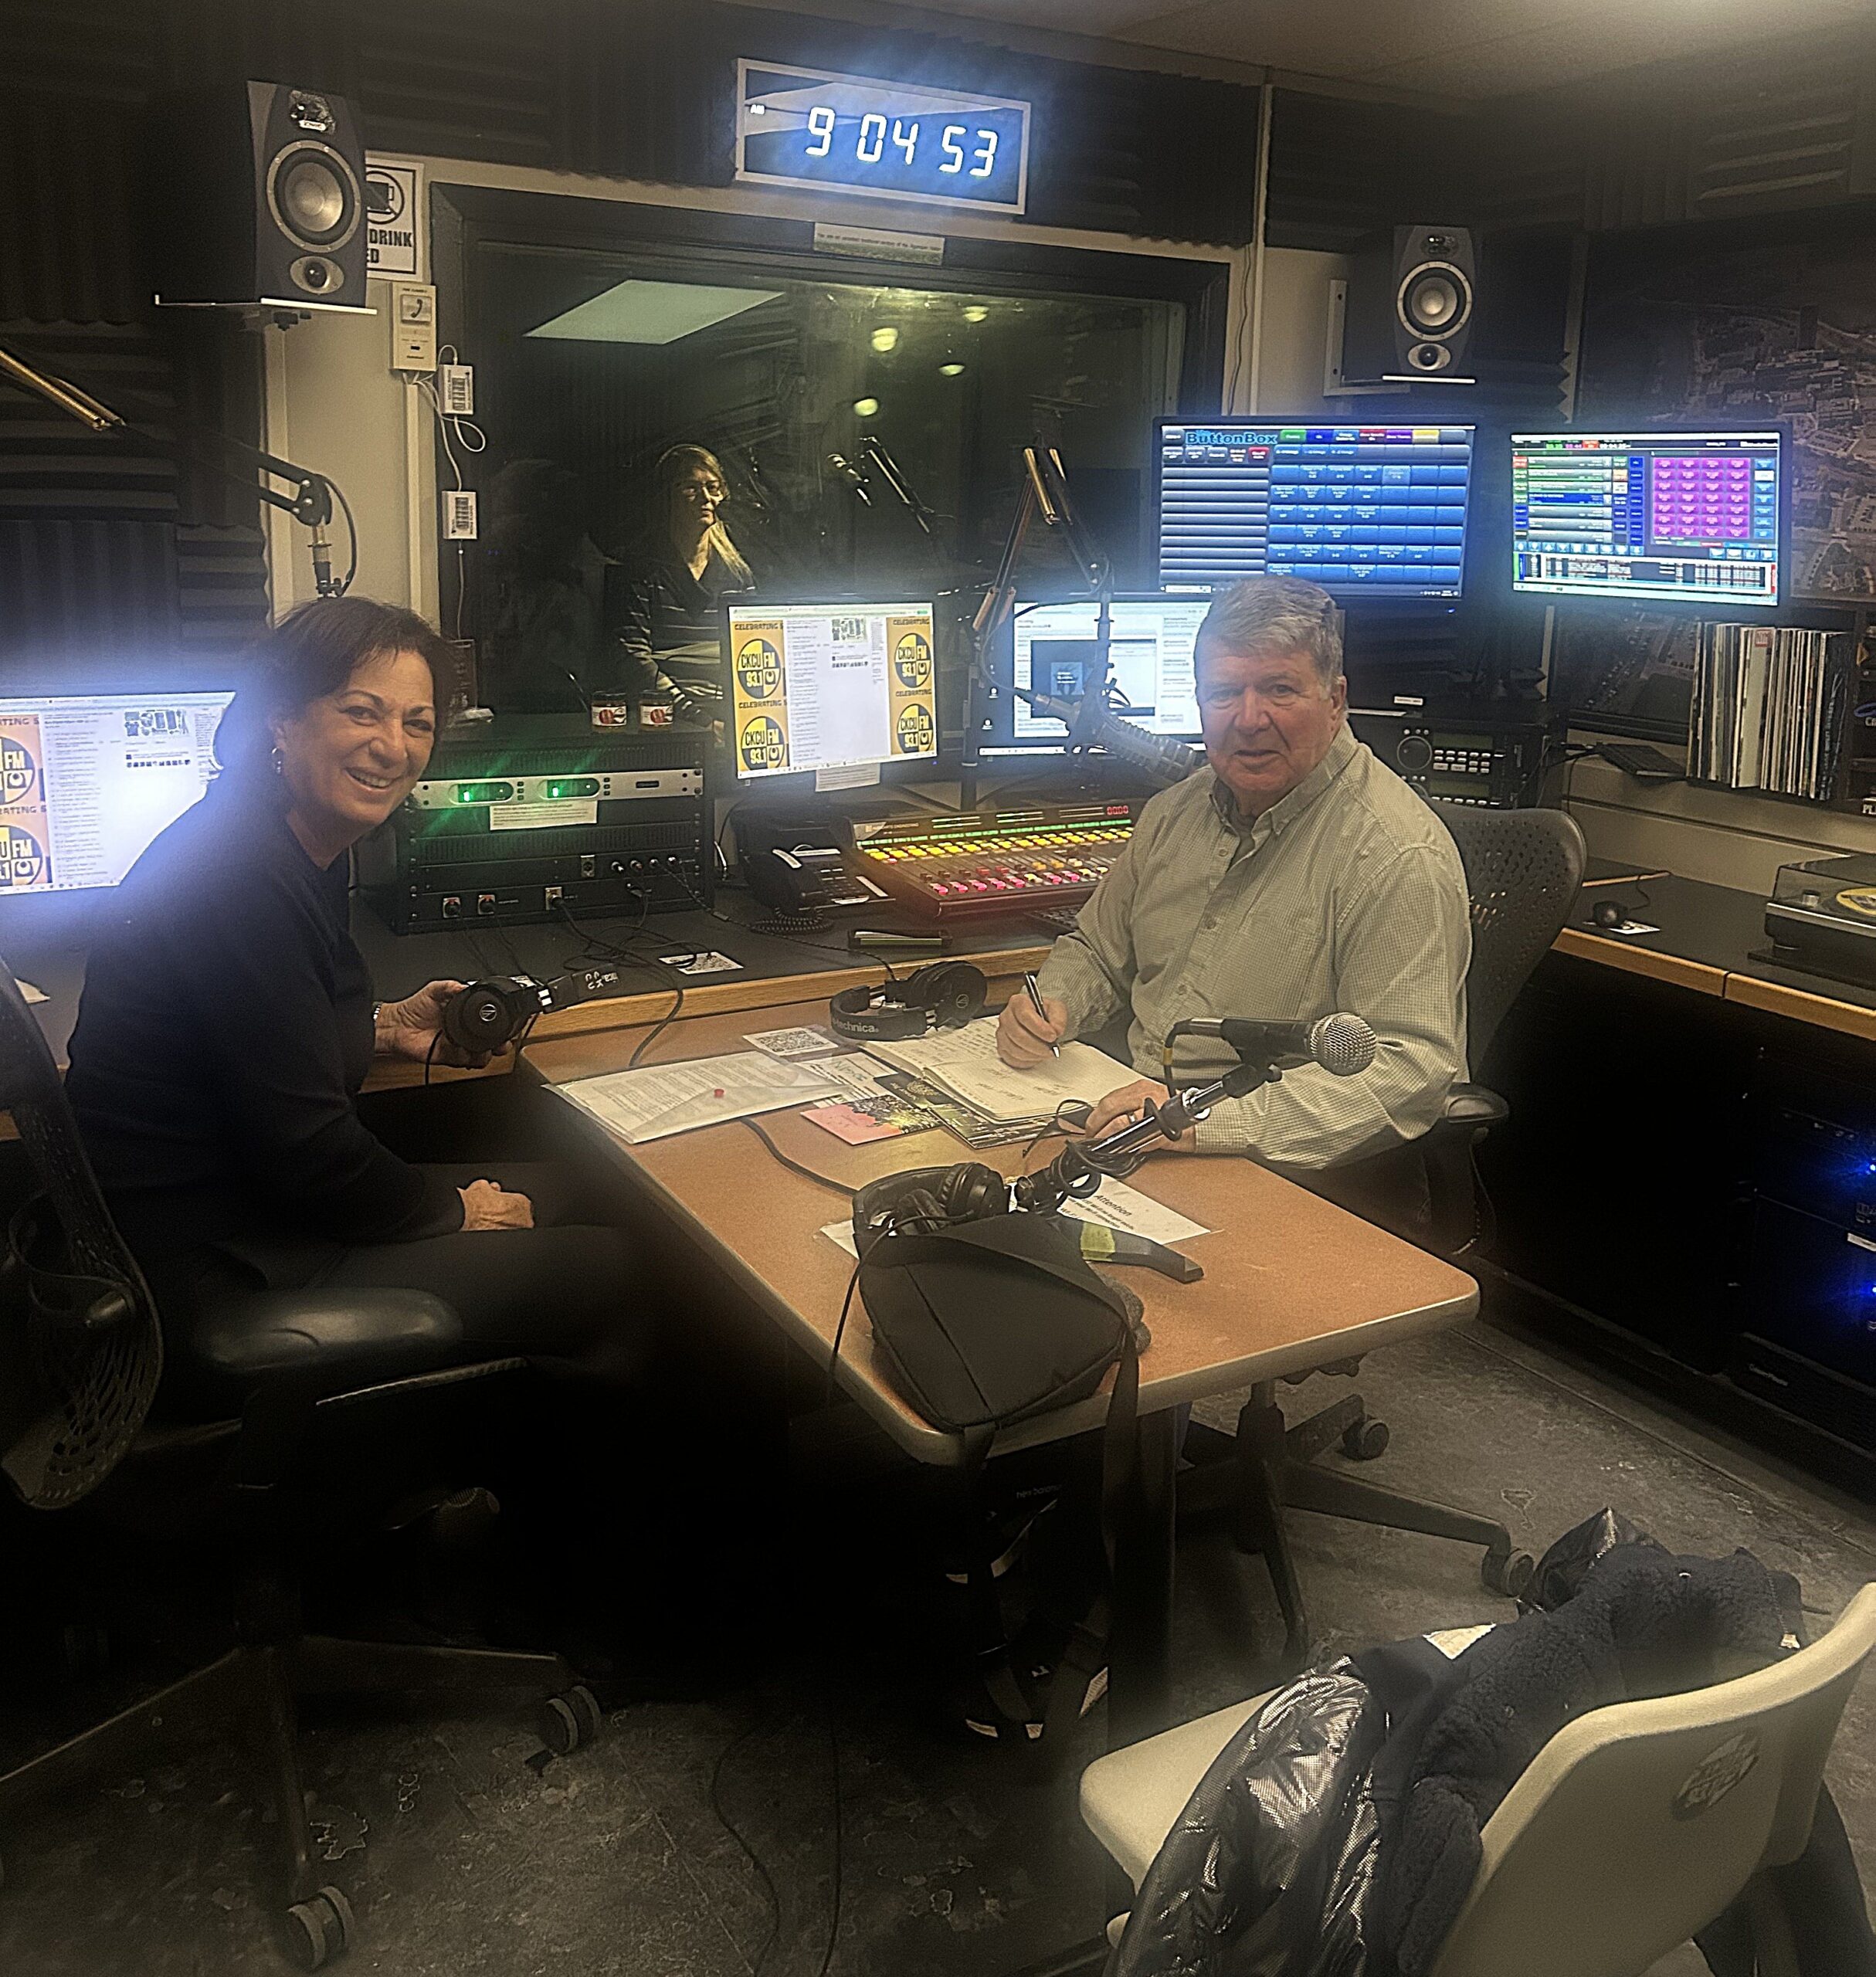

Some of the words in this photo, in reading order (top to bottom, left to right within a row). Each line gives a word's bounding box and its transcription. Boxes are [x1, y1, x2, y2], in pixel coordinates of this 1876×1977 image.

[805, 107, 836, 156] 9
[857, 114, 919, 165] 04
[939, 125, 999, 178] 53
[369, 229, 412, 247] DRINK
[1186, 432, 1278, 445] ButtonBox
[741, 653, 762, 668] CKCU
[745, 731, 765, 745] CKCU
[4, 751, 25, 769] FM
[12, 840, 33, 859] FM
[1094, 1195, 1132, 1216] Attention
